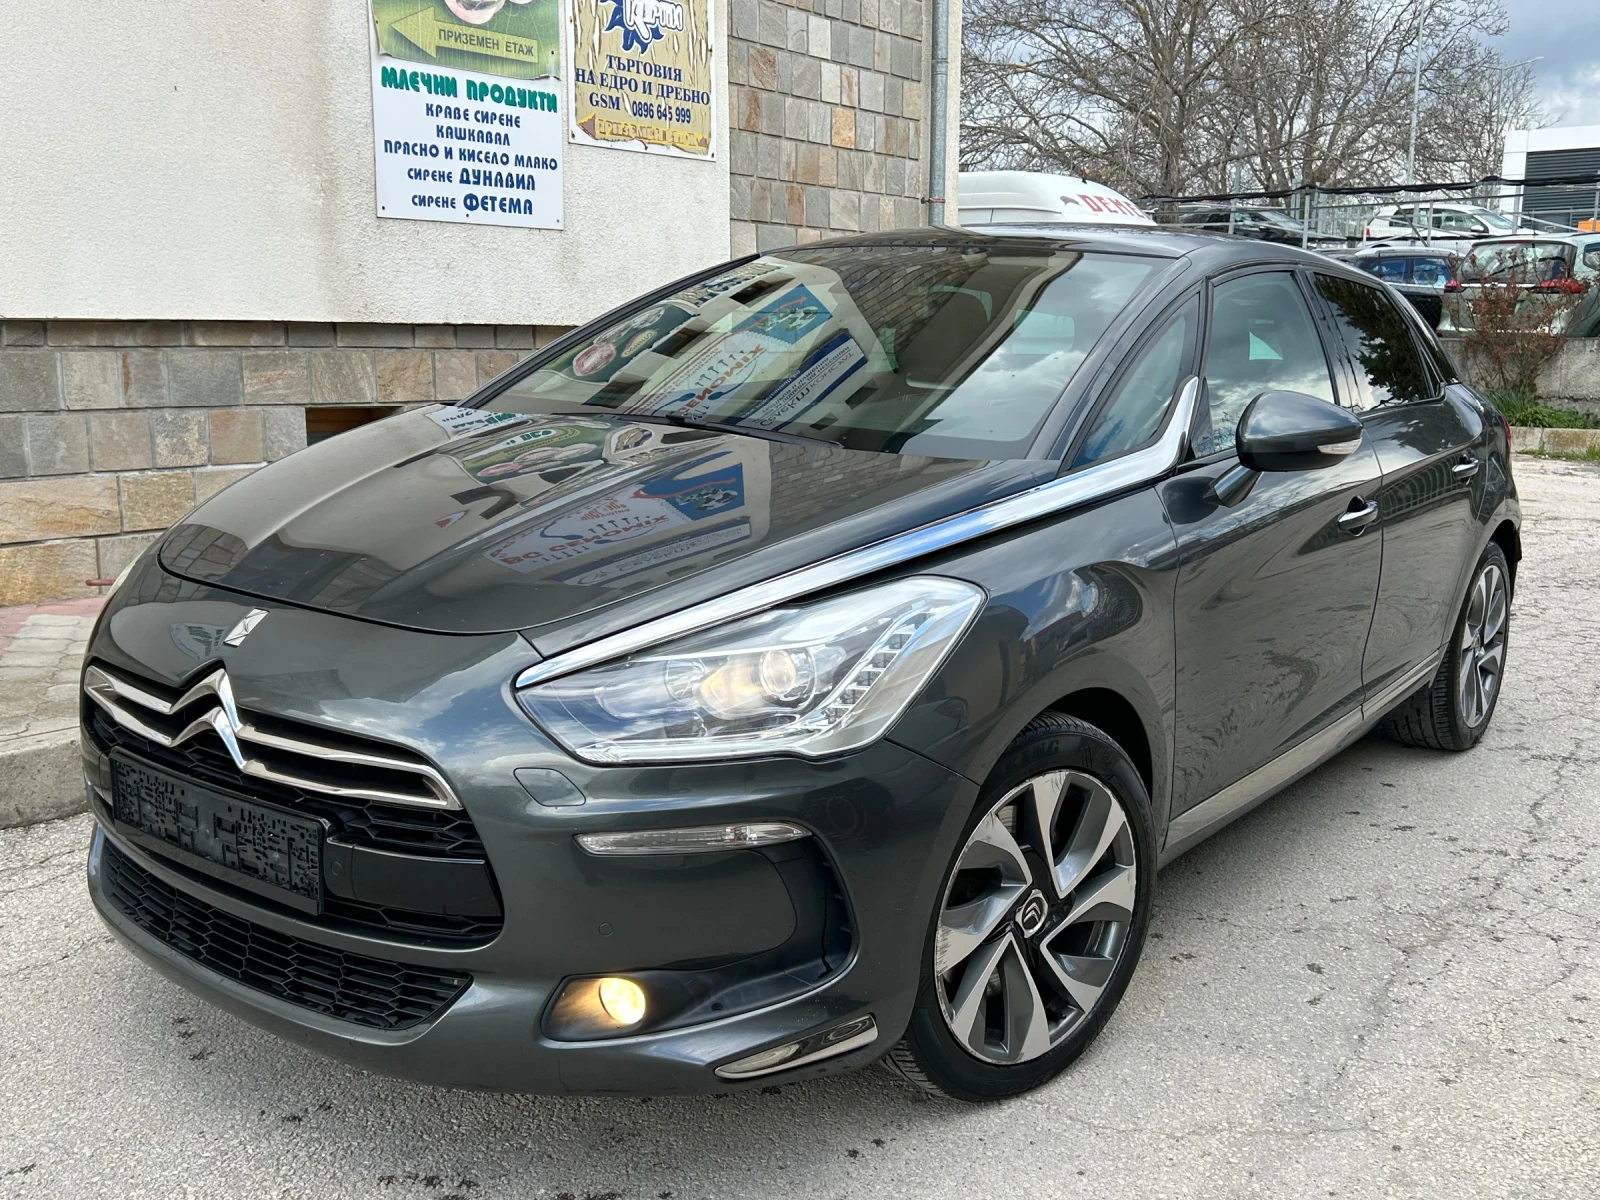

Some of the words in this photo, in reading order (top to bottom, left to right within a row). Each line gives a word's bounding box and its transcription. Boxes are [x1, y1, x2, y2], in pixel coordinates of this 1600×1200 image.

[438, 28, 500, 51] ПРИЗЕМЕН
[505, 41, 534, 57] ЕТАЖ
[606, 54, 683, 83] ТЪРГОВИЯ
[381, 66, 458, 98] МЛЕЧНИ
[466, 79, 558, 113] ПРОДУКТИ
[575, 67, 596, 86] НА
[599, 72, 639, 94] ЕДРО
[641, 80, 653, 96] И
[656, 84, 711, 106] ДРЕБНО
[589, 92, 621, 111] GSM
[632, 100, 655, 119] 0896
[675, 107, 692, 124] 999
[425, 103, 470, 121] КРАВЕ
[474, 110, 521, 129] СИРЕНЕ
[436, 124, 511, 147] КАШКАВАЛ
[384, 139, 440, 158] ПРЯСНО
[444, 146, 453, 160] И
[458, 147, 510, 166] КИСЕЛО
[407, 167, 453, 184] СИРЕНЕ
[459, 167, 536, 191] ДУНАВИЯ
[411, 194, 457, 210] СИРЕНЕ
[463, 192, 534, 216] ФЕТЕМА
